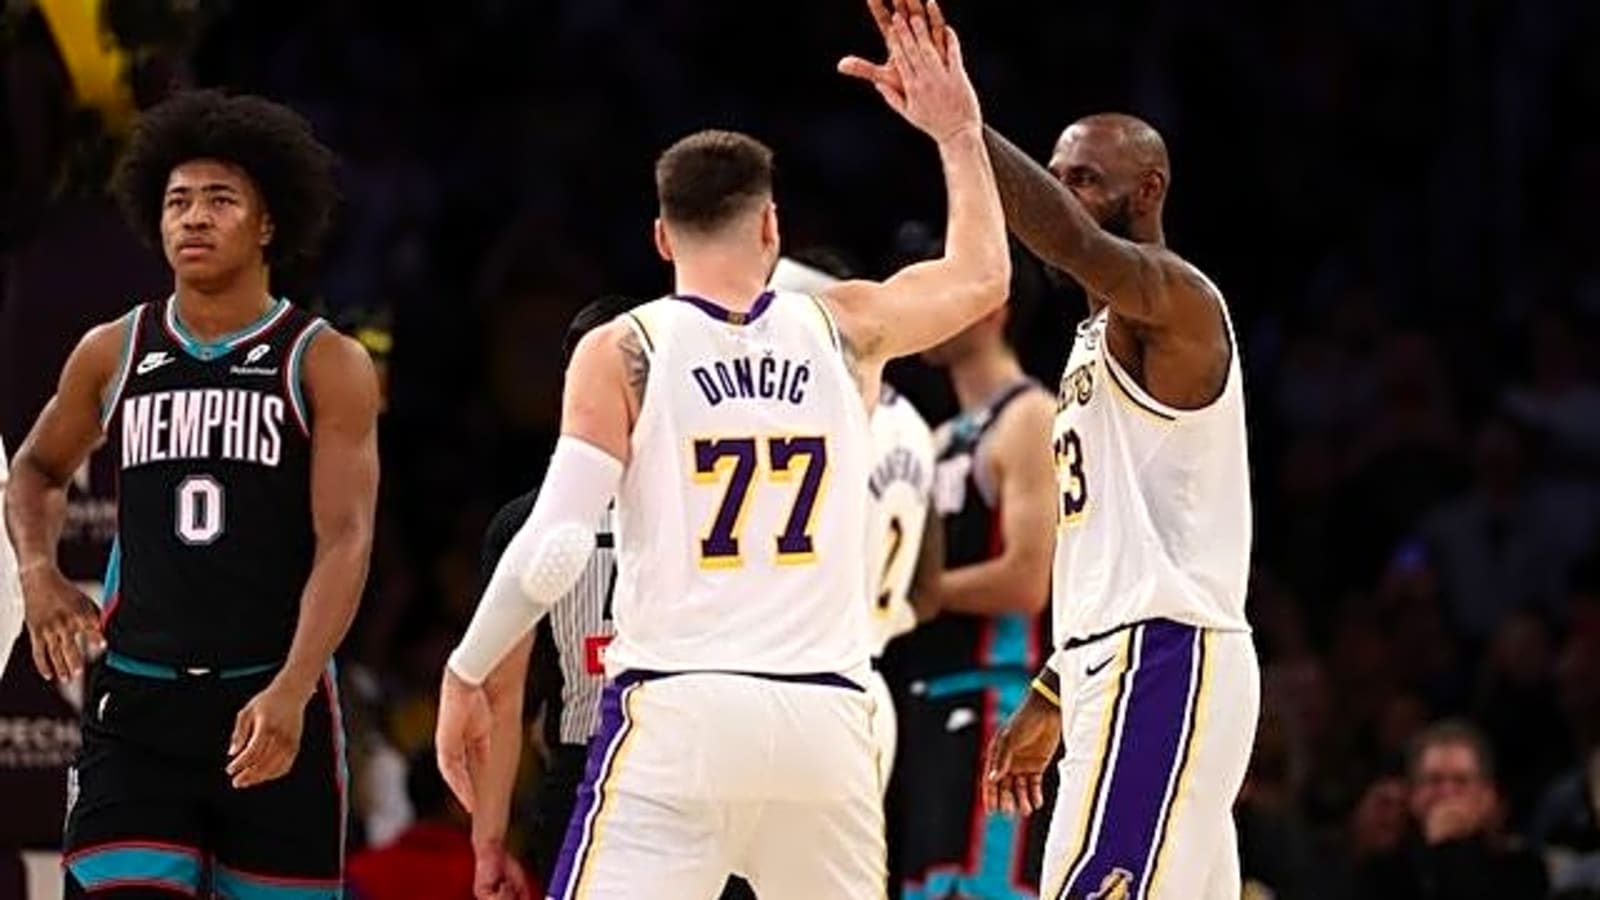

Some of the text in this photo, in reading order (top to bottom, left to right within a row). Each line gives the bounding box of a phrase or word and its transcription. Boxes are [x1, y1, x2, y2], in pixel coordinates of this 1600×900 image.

[692, 350, 810, 405] DONČIĆ
[121, 389, 284, 470] MEMPHIS
[175, 475, 225, 545] 0
[692, 435, 830, 568] 77
[1054, 428, 1088, 518] 3
